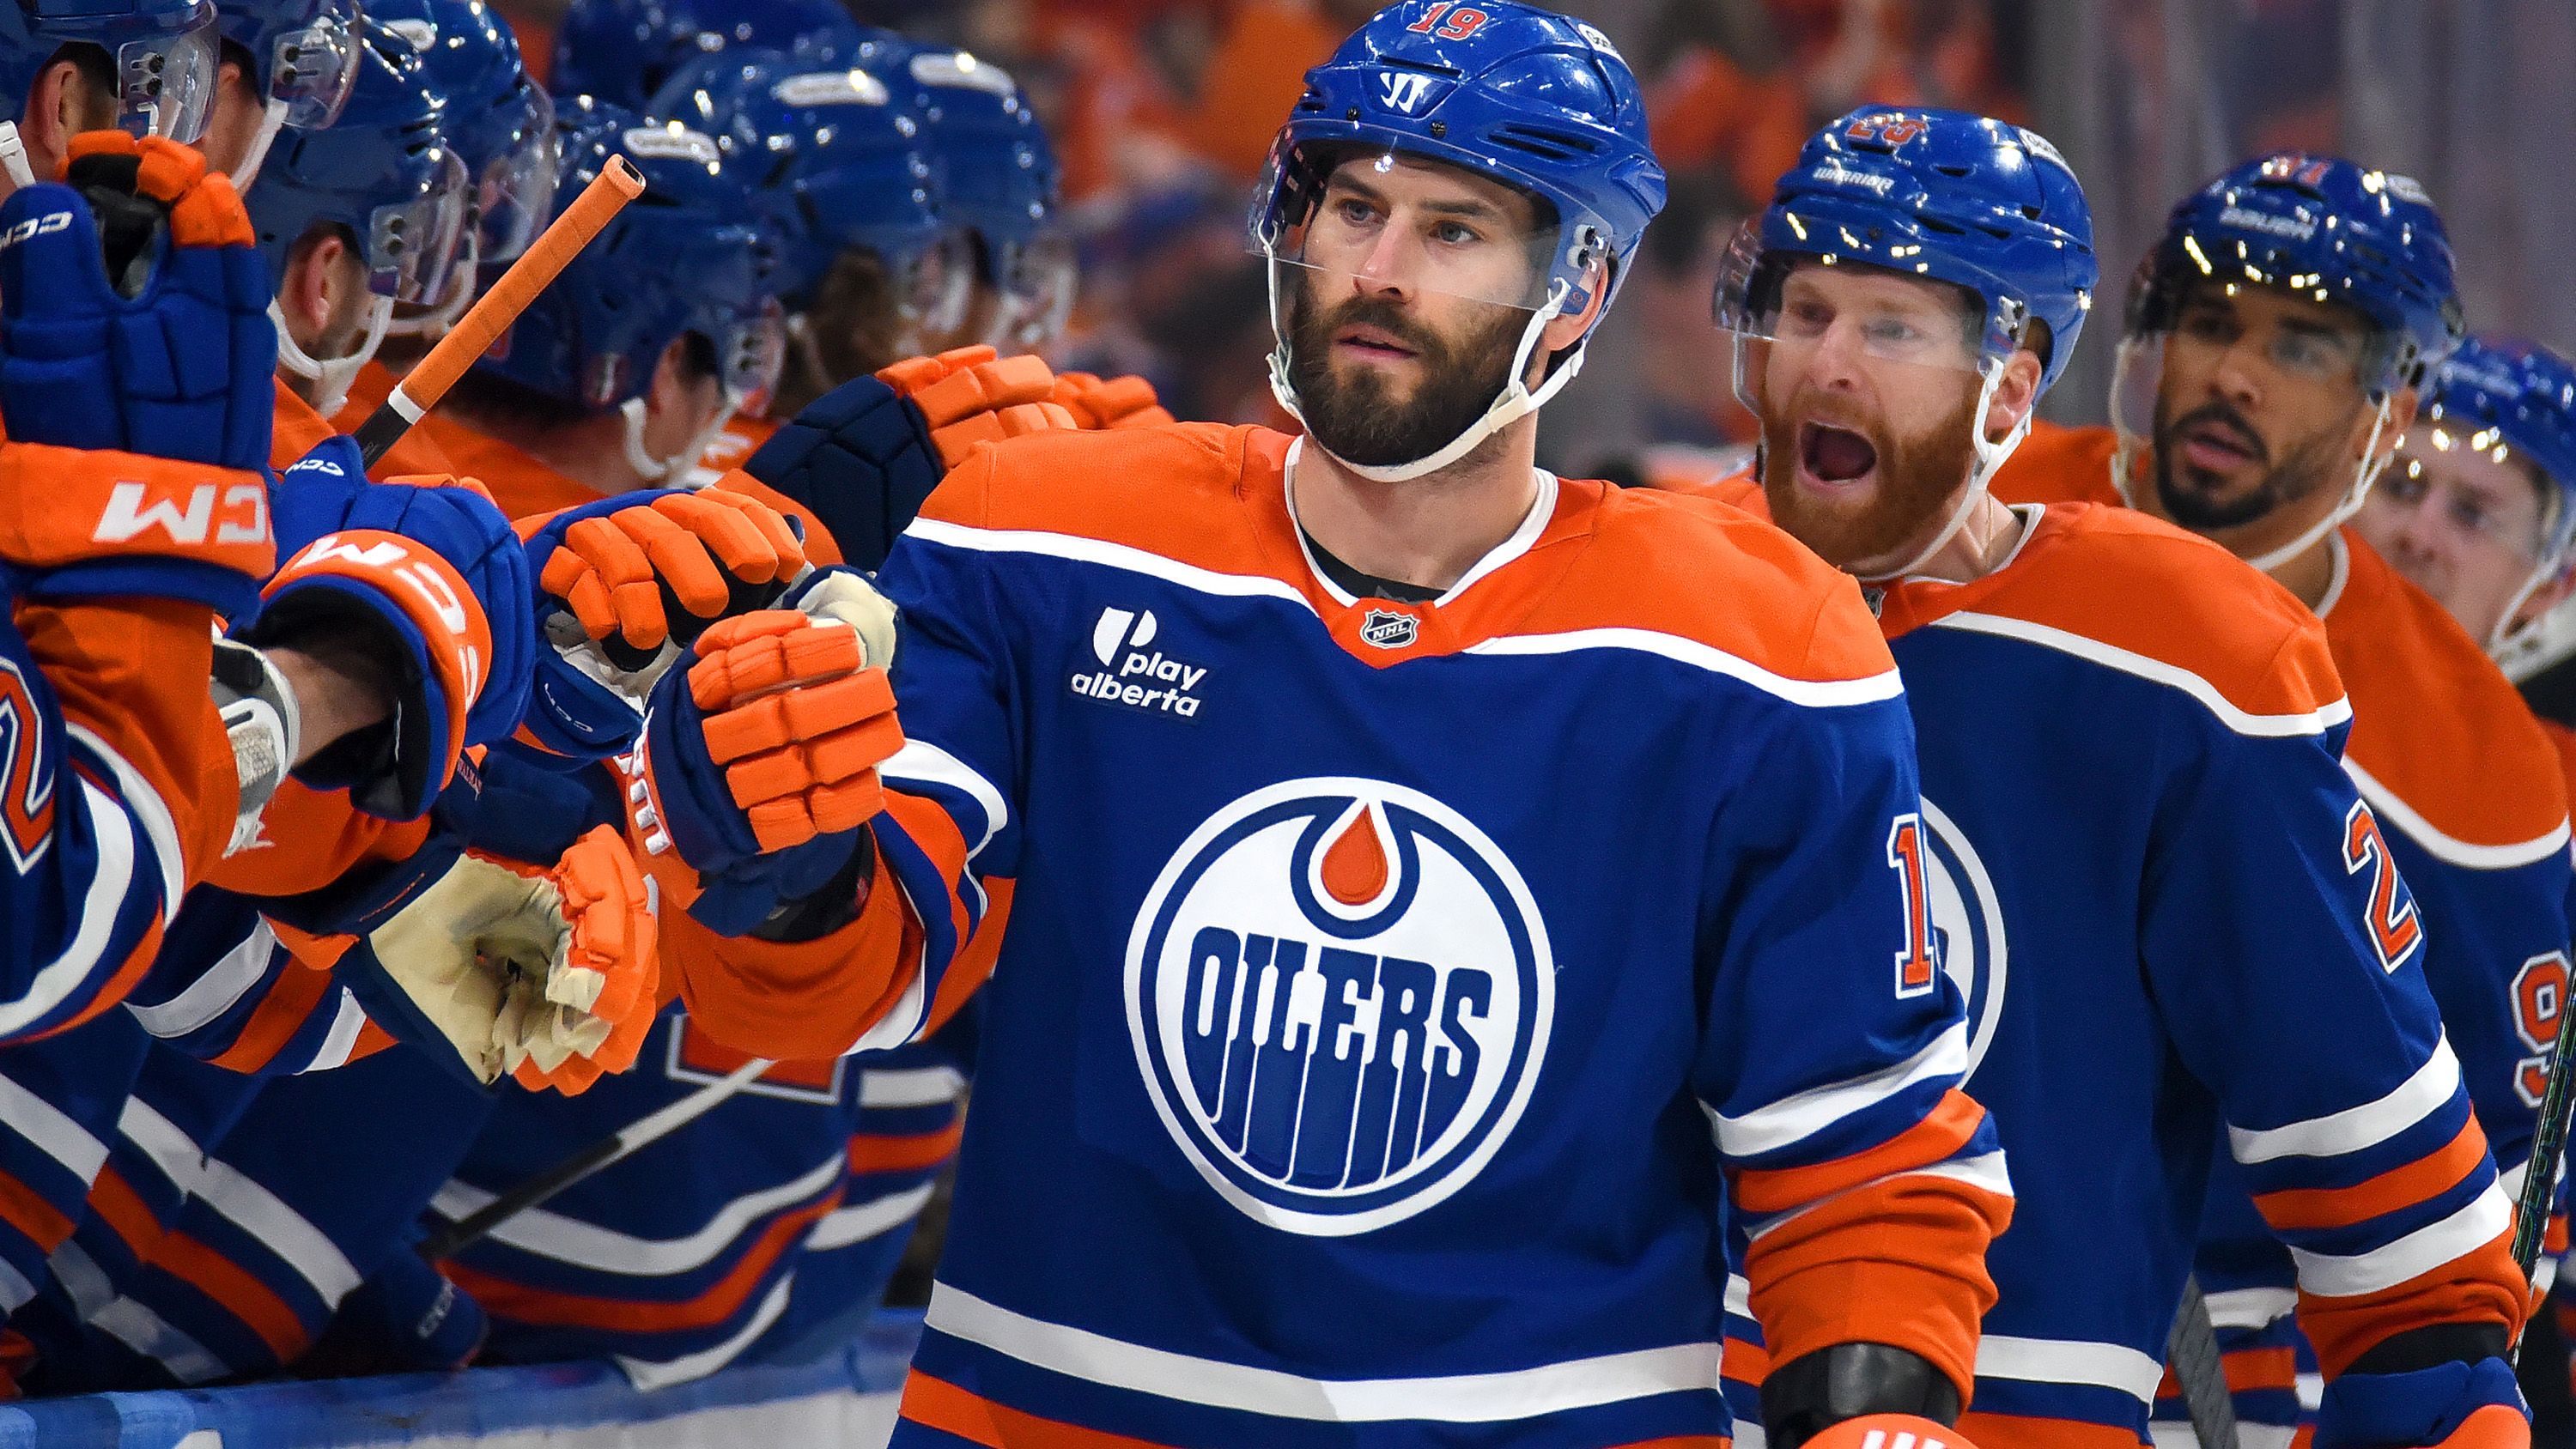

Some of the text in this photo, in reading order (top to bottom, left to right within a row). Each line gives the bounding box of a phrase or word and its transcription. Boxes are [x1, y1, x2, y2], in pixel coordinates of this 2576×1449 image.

[1406, 3, 1489, 41] 19
[92, 481, 276, 544] CM
[1372, 622, 1409, 642] NHL
[1071, 671, 1200, 717] alberta
[1119, 652, 1207, 691] play
[1886, 812, 1934, 999] 1
[2342, 797, 2423, 975] 2
[1182, 925, 1492, 1191] OILERS
